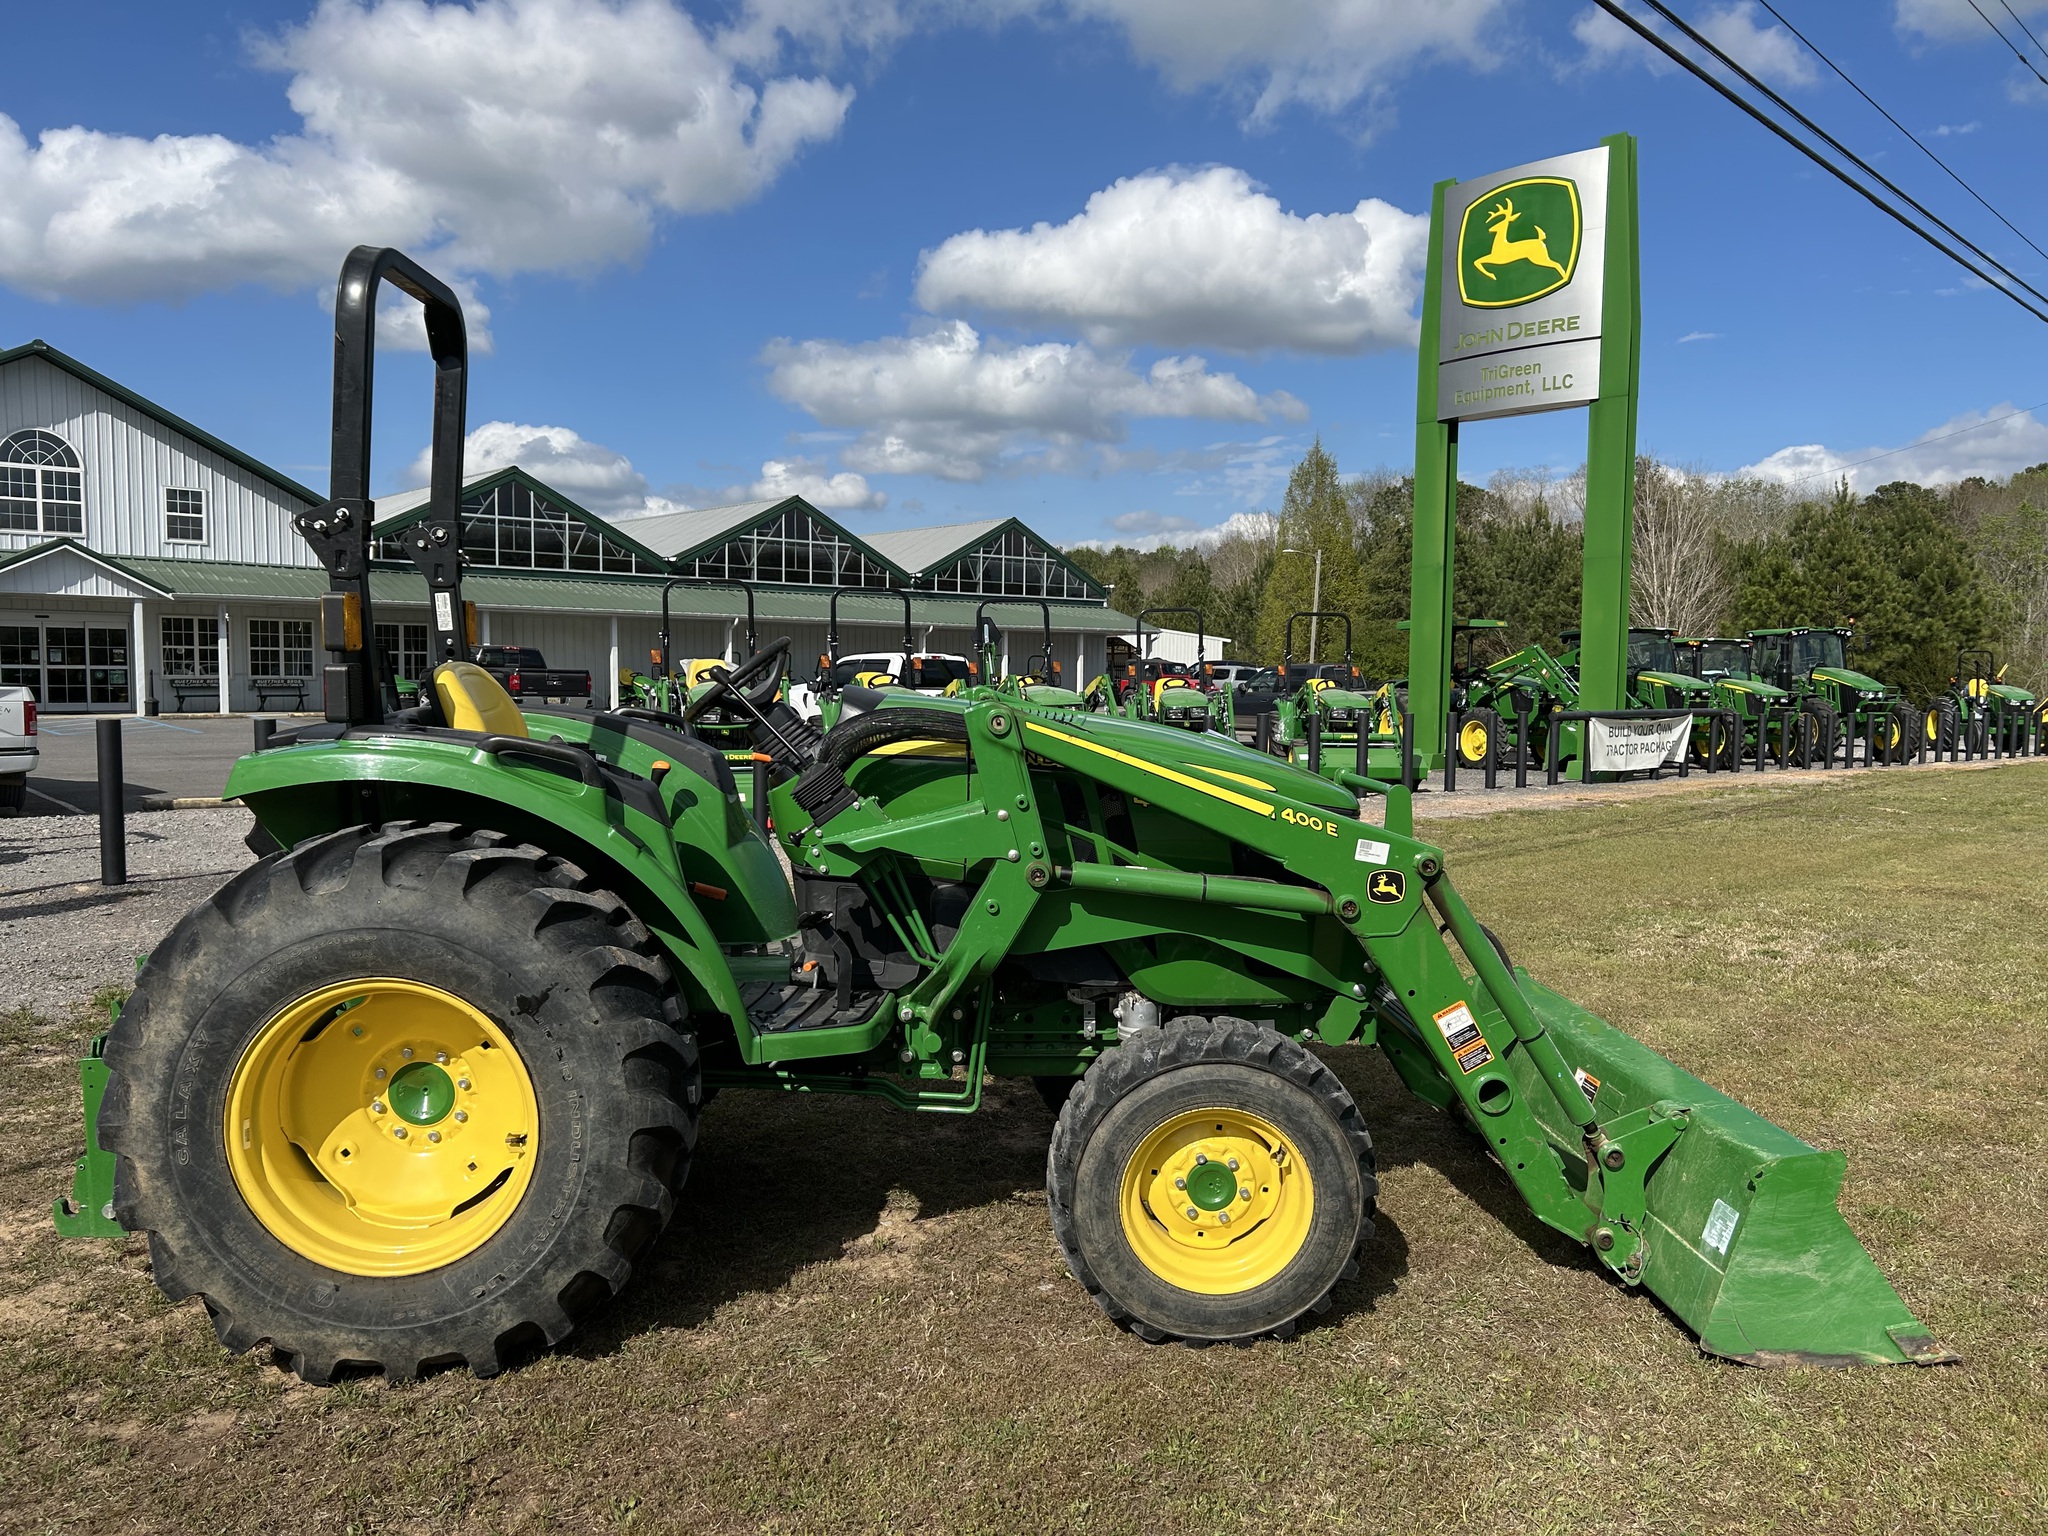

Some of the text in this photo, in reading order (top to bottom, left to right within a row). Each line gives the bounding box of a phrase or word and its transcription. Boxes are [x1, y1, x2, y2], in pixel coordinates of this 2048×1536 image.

[1453, 315, 1580, 351] JOHN DEERE
[1480, 362, 1542, 383] TriGreen
[1454, 374, 1574, 406] Equipment, LLC
[1608, 723, 1673, 738] BUILD YOUR OWN
[1606, 742, 1639, 757] TRACTOR
[1281, 807, 1339, 837] 400 E
[175, 1029, 211, 1166] GALAXY
[522, 1089, 582, 1255] INDUSTRIAL
[470, 1260, 523, 1299] LUG
